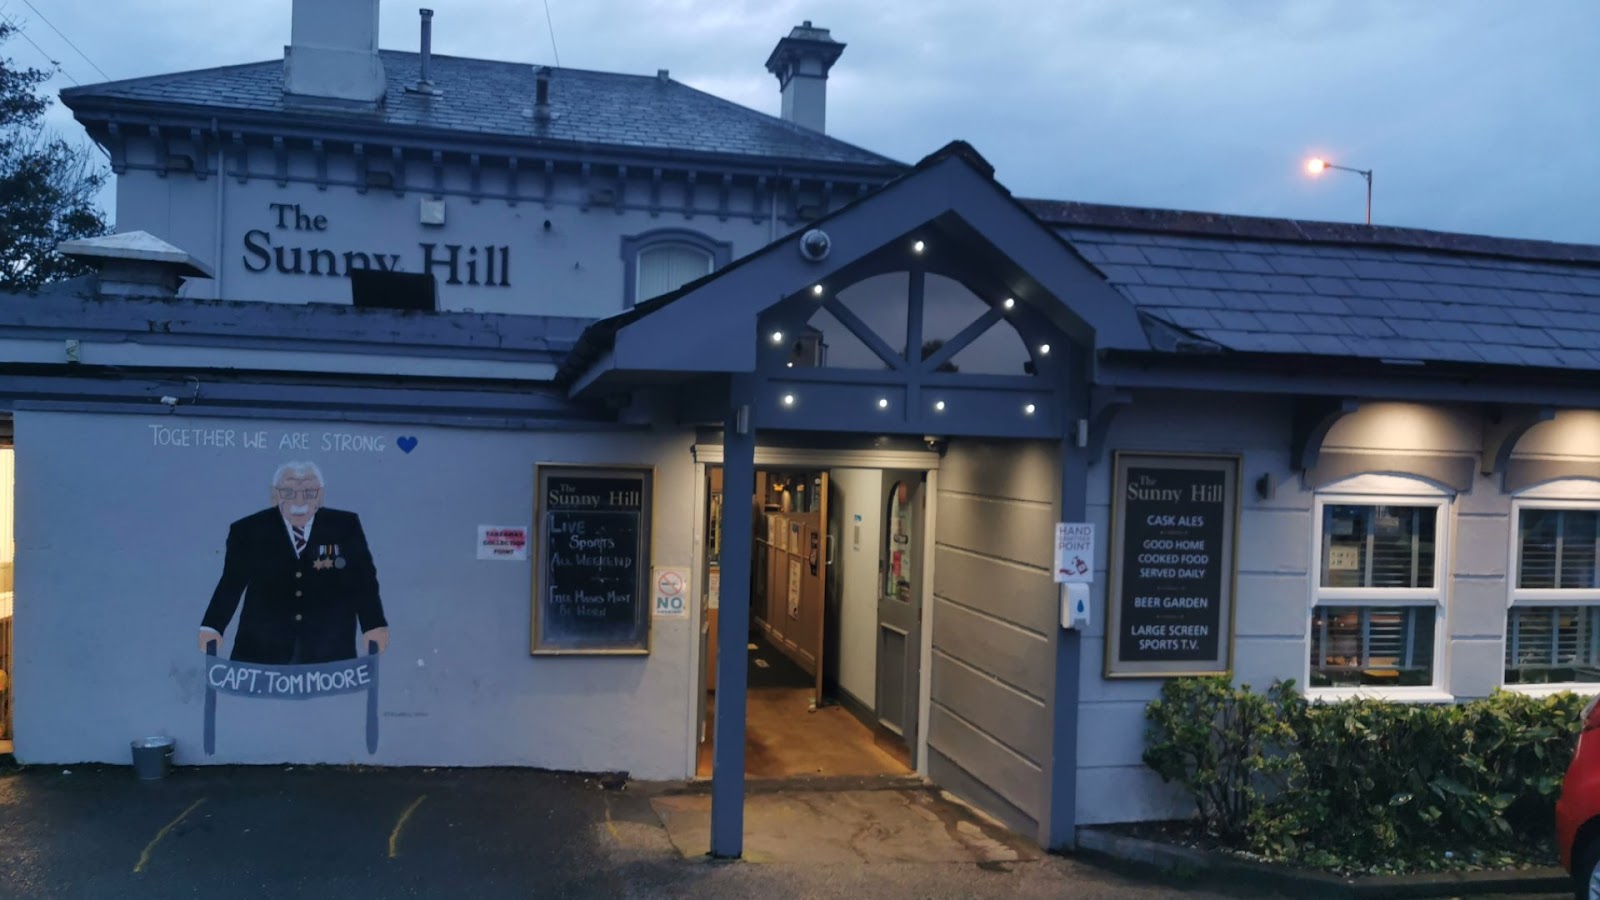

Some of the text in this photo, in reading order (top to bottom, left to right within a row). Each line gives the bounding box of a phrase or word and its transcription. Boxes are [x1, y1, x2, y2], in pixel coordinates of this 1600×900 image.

[270, 203, 328, 231] The
[419, 243, 511, 287] Hill
[148, 424, 386, 453] TOGETHER WE ARE STRONG
[1140, 475, 1157, 486] The
[560, 483, 576, 492] The
[549, 490, 640, 508] Sunny Hill
[1128, 483, 1222, 504] Sunny Hill
[1146, 515, 1203, 527] CASK ALES
[1060, 526, 1091, 536] HAND
[1059, 542, 1090, 551] POINT
[1143, 539, 1204, 550] GOOD HOME
[1138, 554, 1208, 564] COOKED FOOD
[1139, 567, 1205, 579] SERVED DAILY
[657, 597, 682, 609] NO
[1134, 597, 1208, 608] BEER GARDEN
[1131, 625, 1208, 636] LARGE SCREEN
[1139, 639, 1199, 650] SPORTS T.V.
[209, 664, 370, 694] CAPT. TOM MOORE
